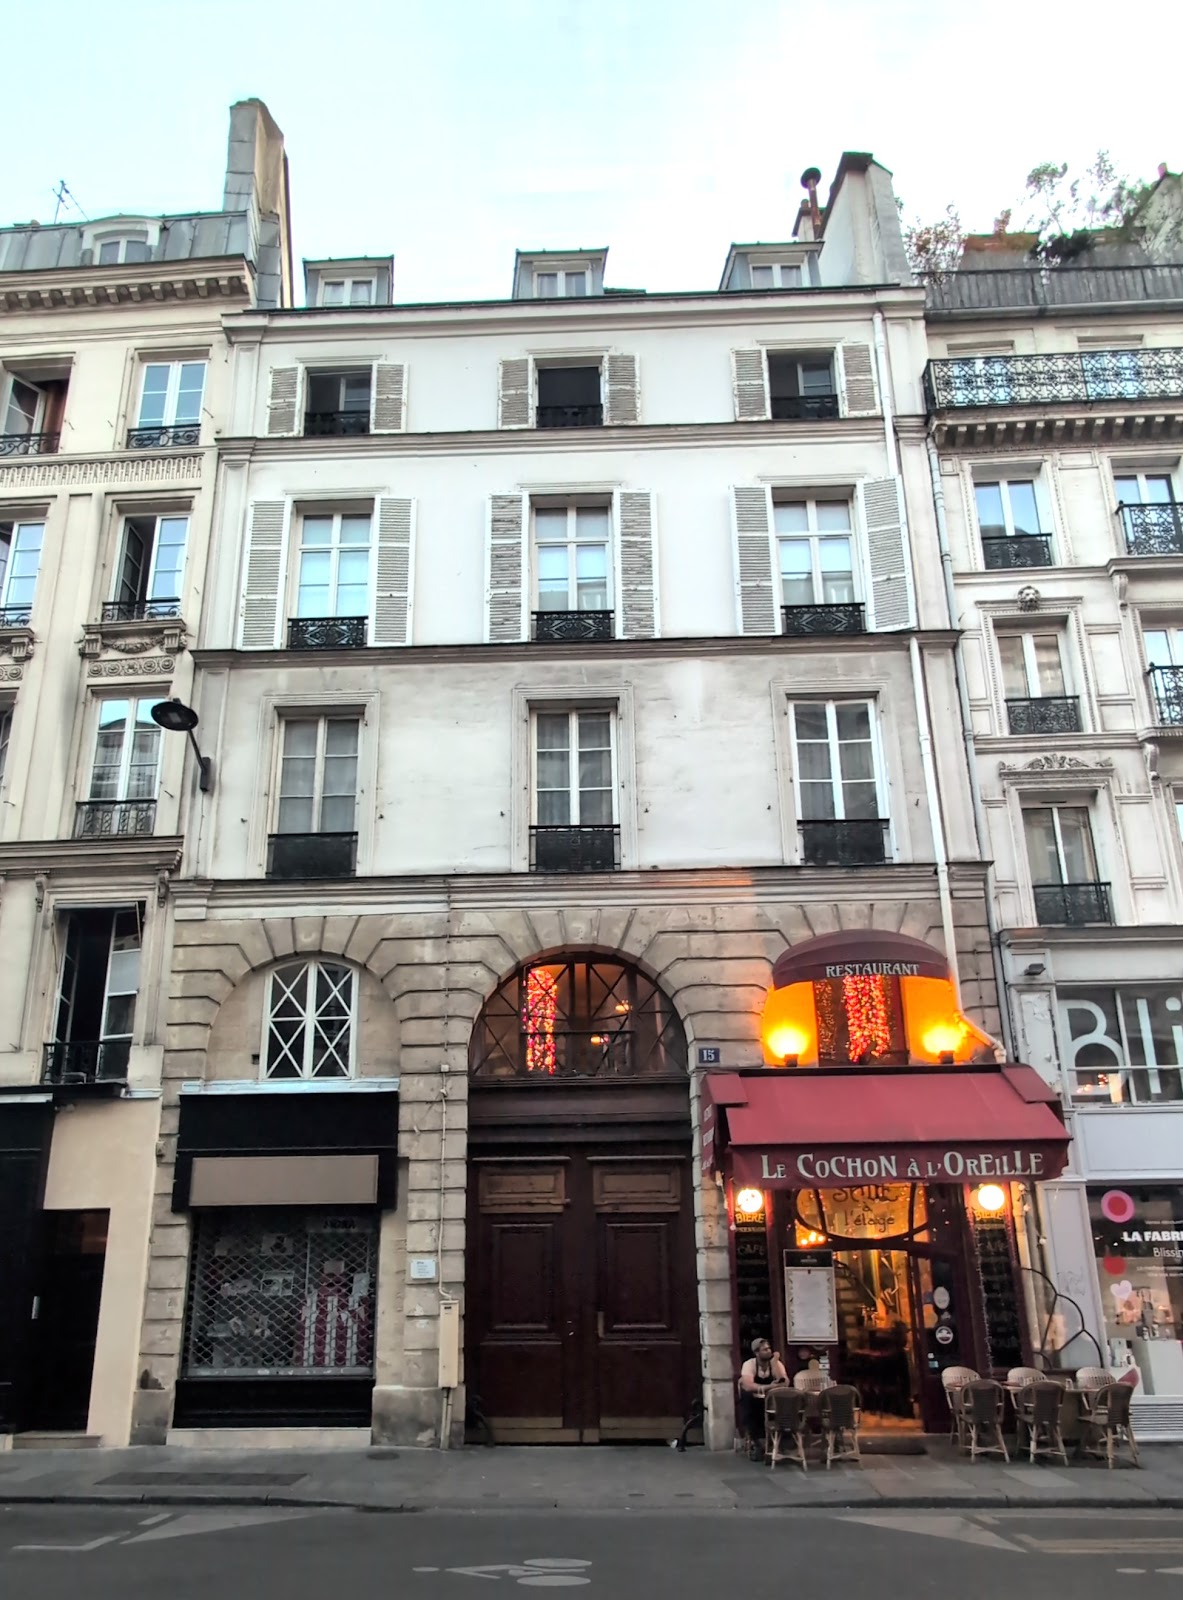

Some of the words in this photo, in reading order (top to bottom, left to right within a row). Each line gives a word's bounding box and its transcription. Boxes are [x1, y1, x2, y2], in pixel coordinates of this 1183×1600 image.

[825, 963, 919, 977] RESTAURANT
[703, 1049, 715, 1061] 15
[1121, 1231, 1143, 1242] LA
